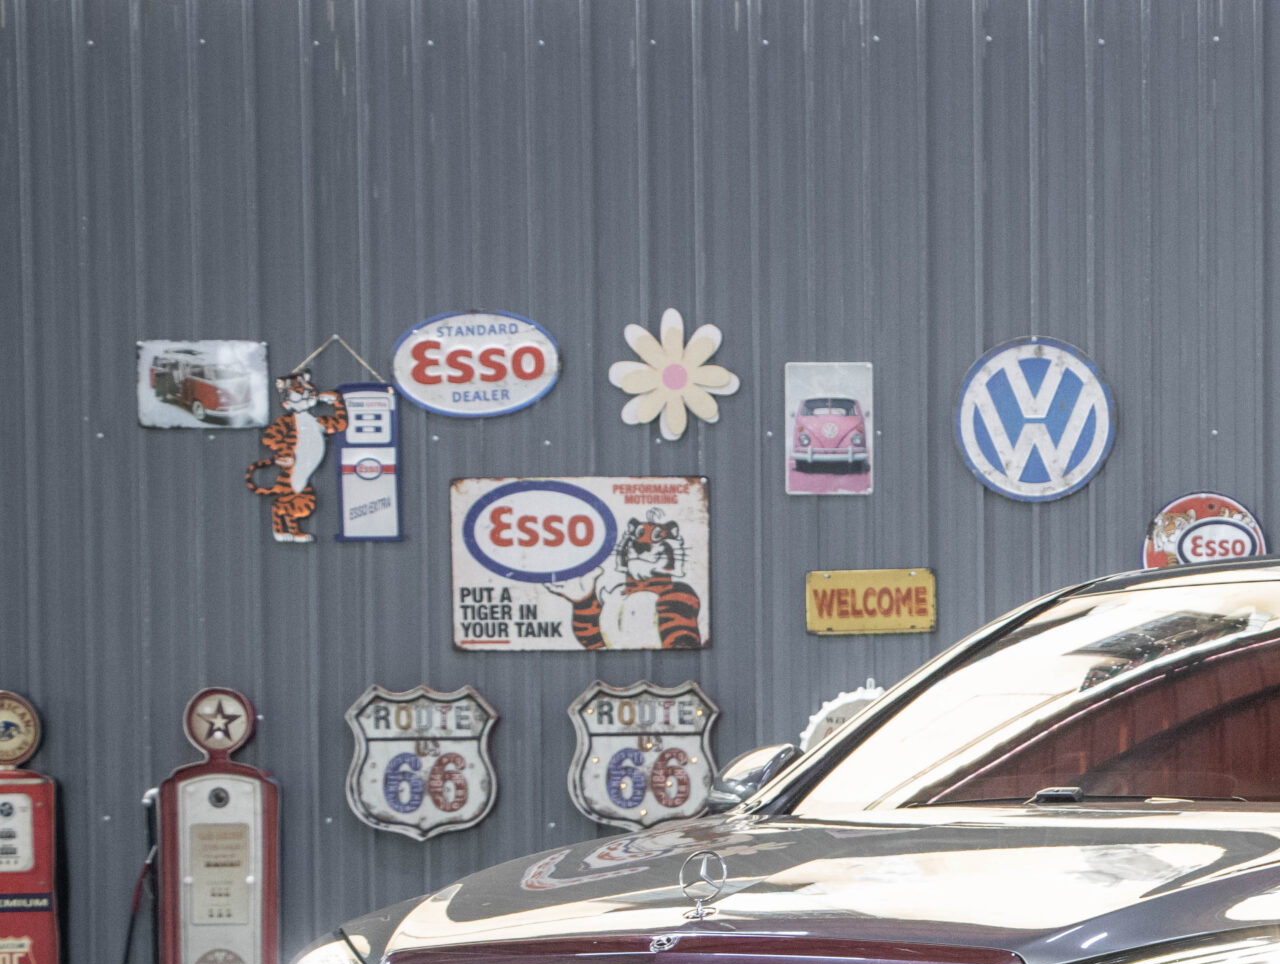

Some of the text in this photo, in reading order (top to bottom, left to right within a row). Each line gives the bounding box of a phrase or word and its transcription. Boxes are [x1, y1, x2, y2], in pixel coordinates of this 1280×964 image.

[436, 323, 519, 338] STANDARD
[452, 388, 511, 403] DEALER
[612, 483, 691, 495] PERFORMANCE
[624, 494, 679, 505] MOTORING
[459, 587, 513, 604] PUT A
[812, 585, 929, 619] WELCOME
[460, 604, 538, 621] TIGER IN
[460, 621, 563, 639] YOUR TANK
[373, 704, 473, 731] ROUTE
[596, 700, 695, 726] ROUTE
[415, 739, 441, 758] US
[383, 751, 469, 814] 66
[606, 747, 691, 809] 66
